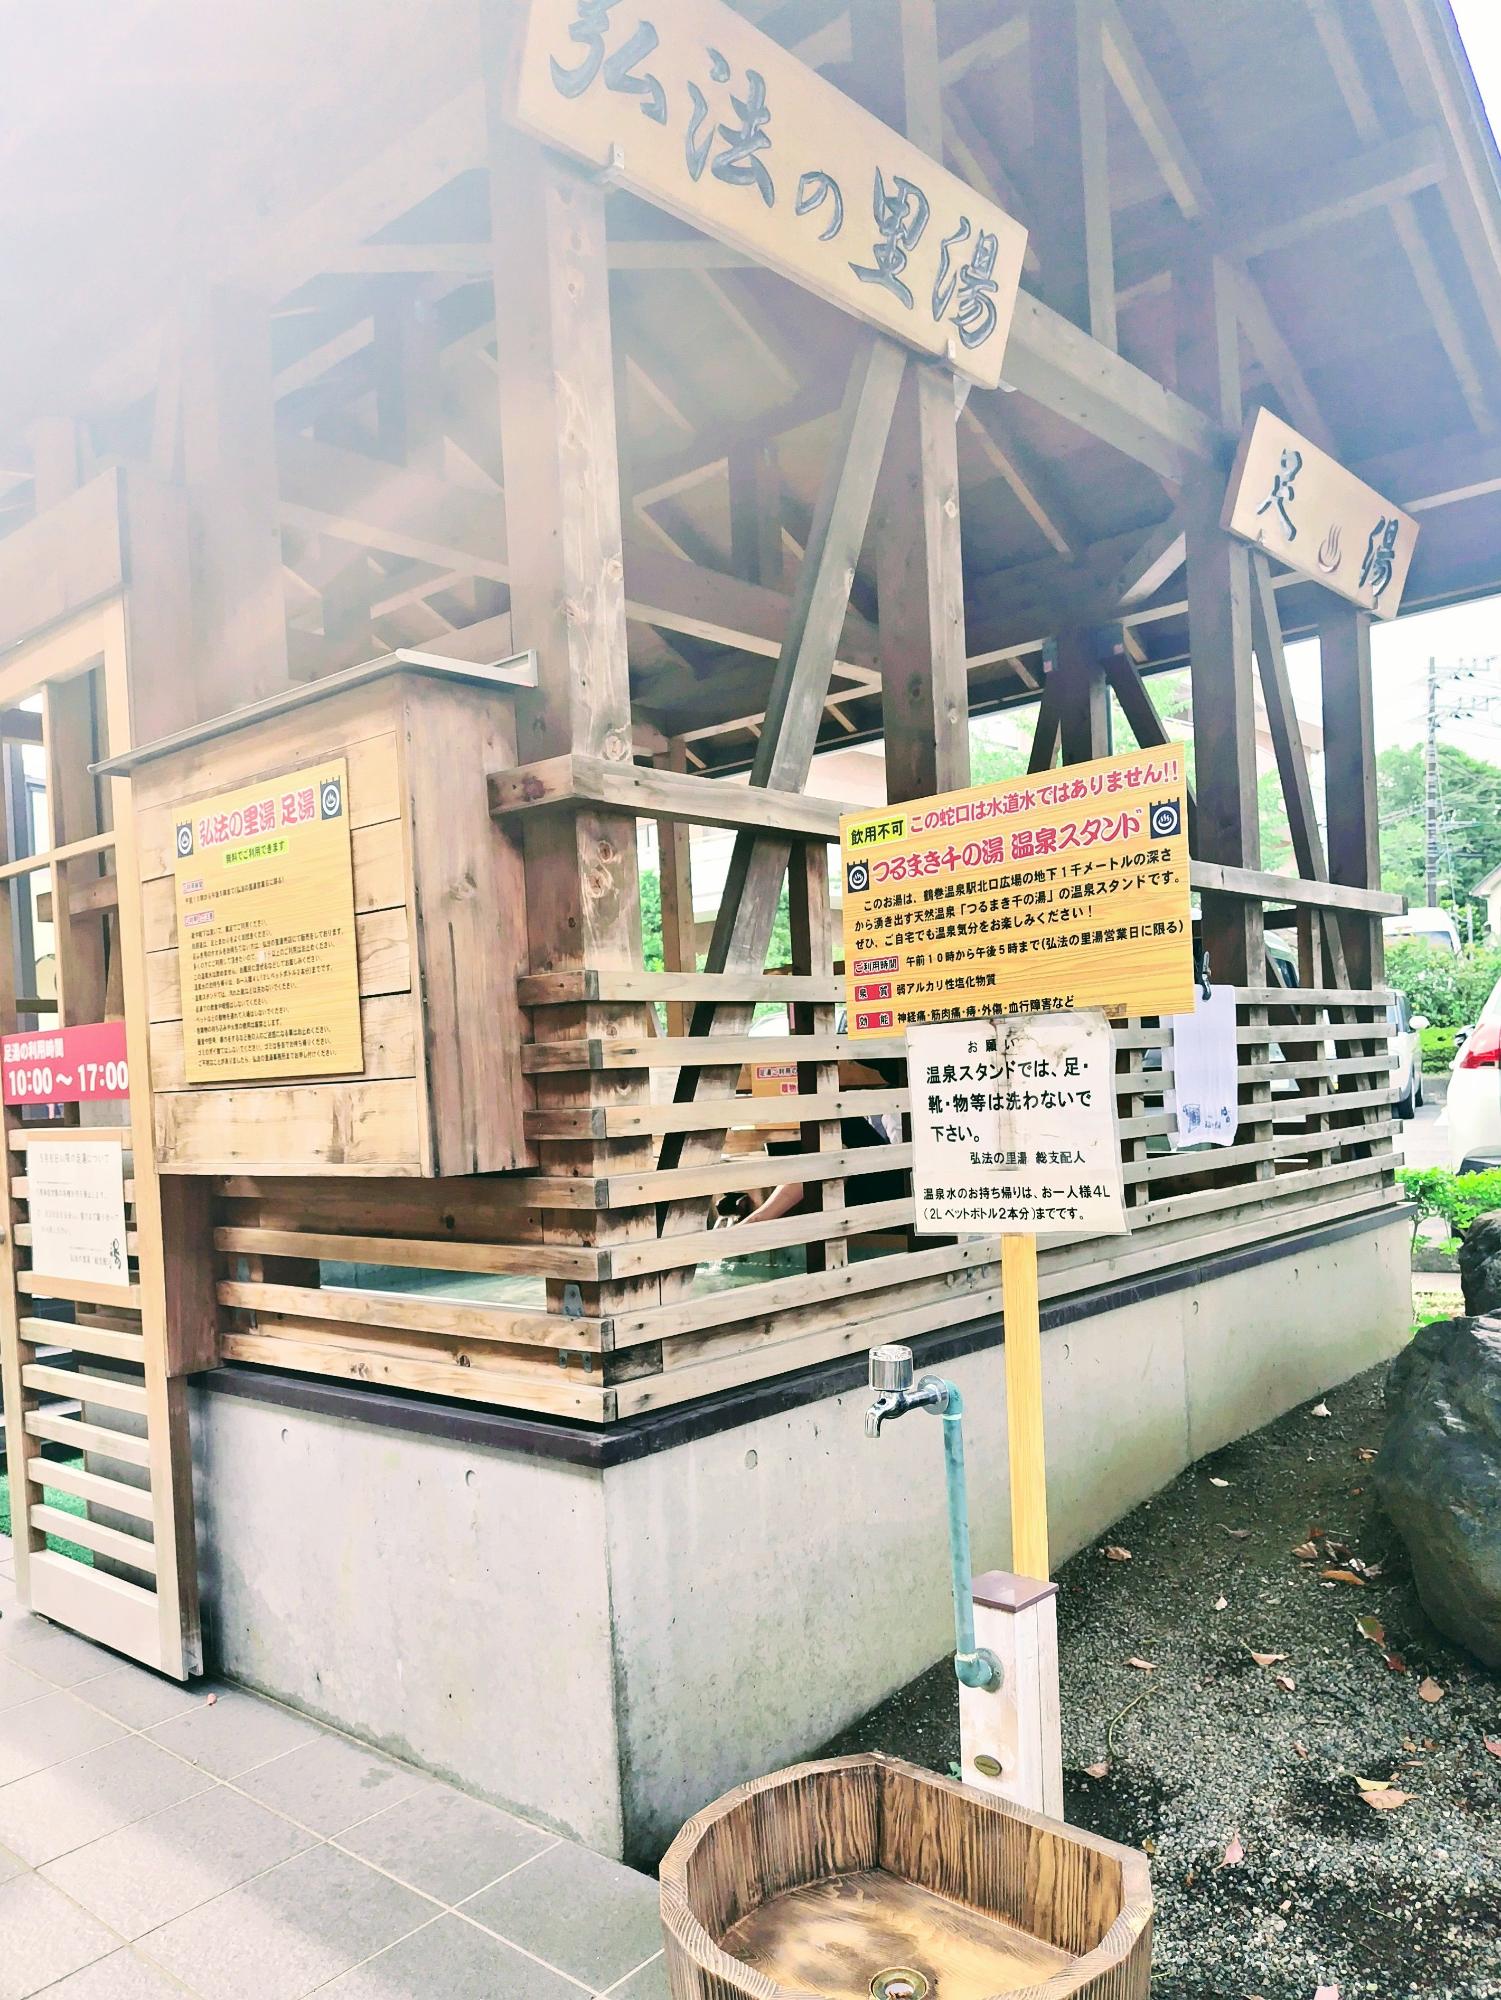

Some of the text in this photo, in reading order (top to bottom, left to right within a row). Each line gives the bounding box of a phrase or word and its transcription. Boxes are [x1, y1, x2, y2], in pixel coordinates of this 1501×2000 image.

[199, 788, 315, 847] 弘法の里湯 足湯
[851, 820, 904, 846] 飲用不可
[872, 808, 1143, 883] つるまき千の湯 温泉スタンド
[854, 958, 898, 975] ご利用時間
[896, 973, 996, 996] 弱アルカリ性塩化物質
[3, 1038, 65, 1063] 足湯の利用時間
[967, 1038, 1015, 1053] お願い
[926, 1057, 1089, 1084] 温泉スタンドでは、足・
[928, 1089, 1092, 1114] 靴・物等は洗わないで
[930, 1124, 980, 1143] 下さい。
[970, 1150, 1086, 1165] 弘法の里湯 総支配人
[923, 1184, 1111, 1201] 温泉水のお持ち帰りは、お一人様4L
